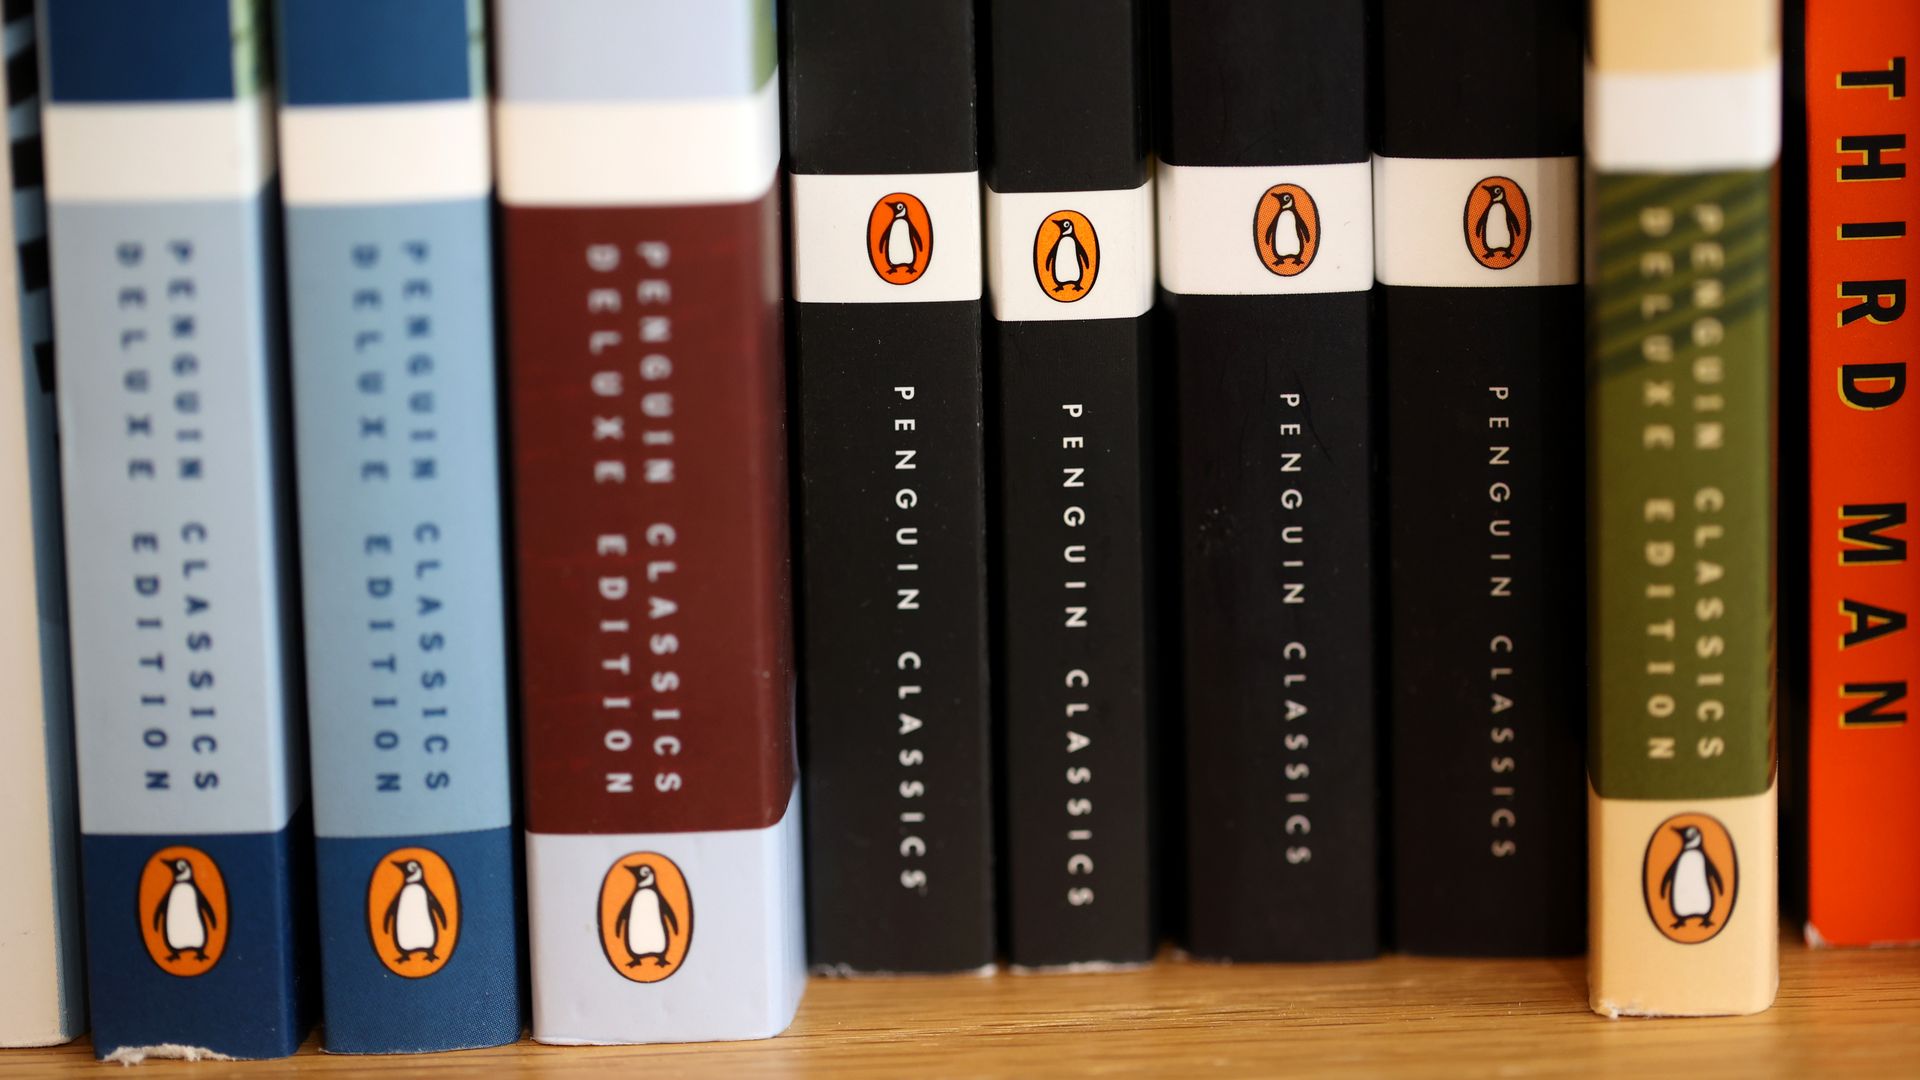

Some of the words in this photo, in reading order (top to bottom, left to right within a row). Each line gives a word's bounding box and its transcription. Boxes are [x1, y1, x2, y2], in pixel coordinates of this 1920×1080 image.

[1639, 206, 1676, 448] DELUXE
[1693, 204, 1725, 450] PENGUIN
[1836, 57, 1906, 410] THIRD
[115, 242, 155, 478] DELUXE
[167, 240, 203, 480] PENGUIN
[350, 244, 389, 481] DELUXE
[402, 241, 437, 480] PENGUIN
[587, 244, 626, 482] DELUXE
[637, 242, 674, 483] PENGUIN
[894, 386, 920, 610] PENGUIN
[1062, 403, 1088, 628] PENGUIN
[1279, 393, 1305, 604] PENGUIN
[1488, 386, 1511, 597] PENGUIN
[131, 533, 171, 791] EDITION
[180, 522, 220, 791] CLASSICS
[364, 534, 401, 793] EDITION
[413, 522, 451, 791] CLASSICS
[597, 534, 634, 793] EDITION
[646, 523, 682, 793] CLASSICS
[1644, 498, 1677, 760] EDITION
[1694, 486, 1726, 760] CLASSICS
[1838, 502, 1907, 727] MAN
[897, 651, 926, 888] CLASSICS
[1065, 669, 1094, 906] CLASSICS
[1283, 641, 1311, 864] CLASSICS
[1490, 635, 1516, 857] CLASSICS
